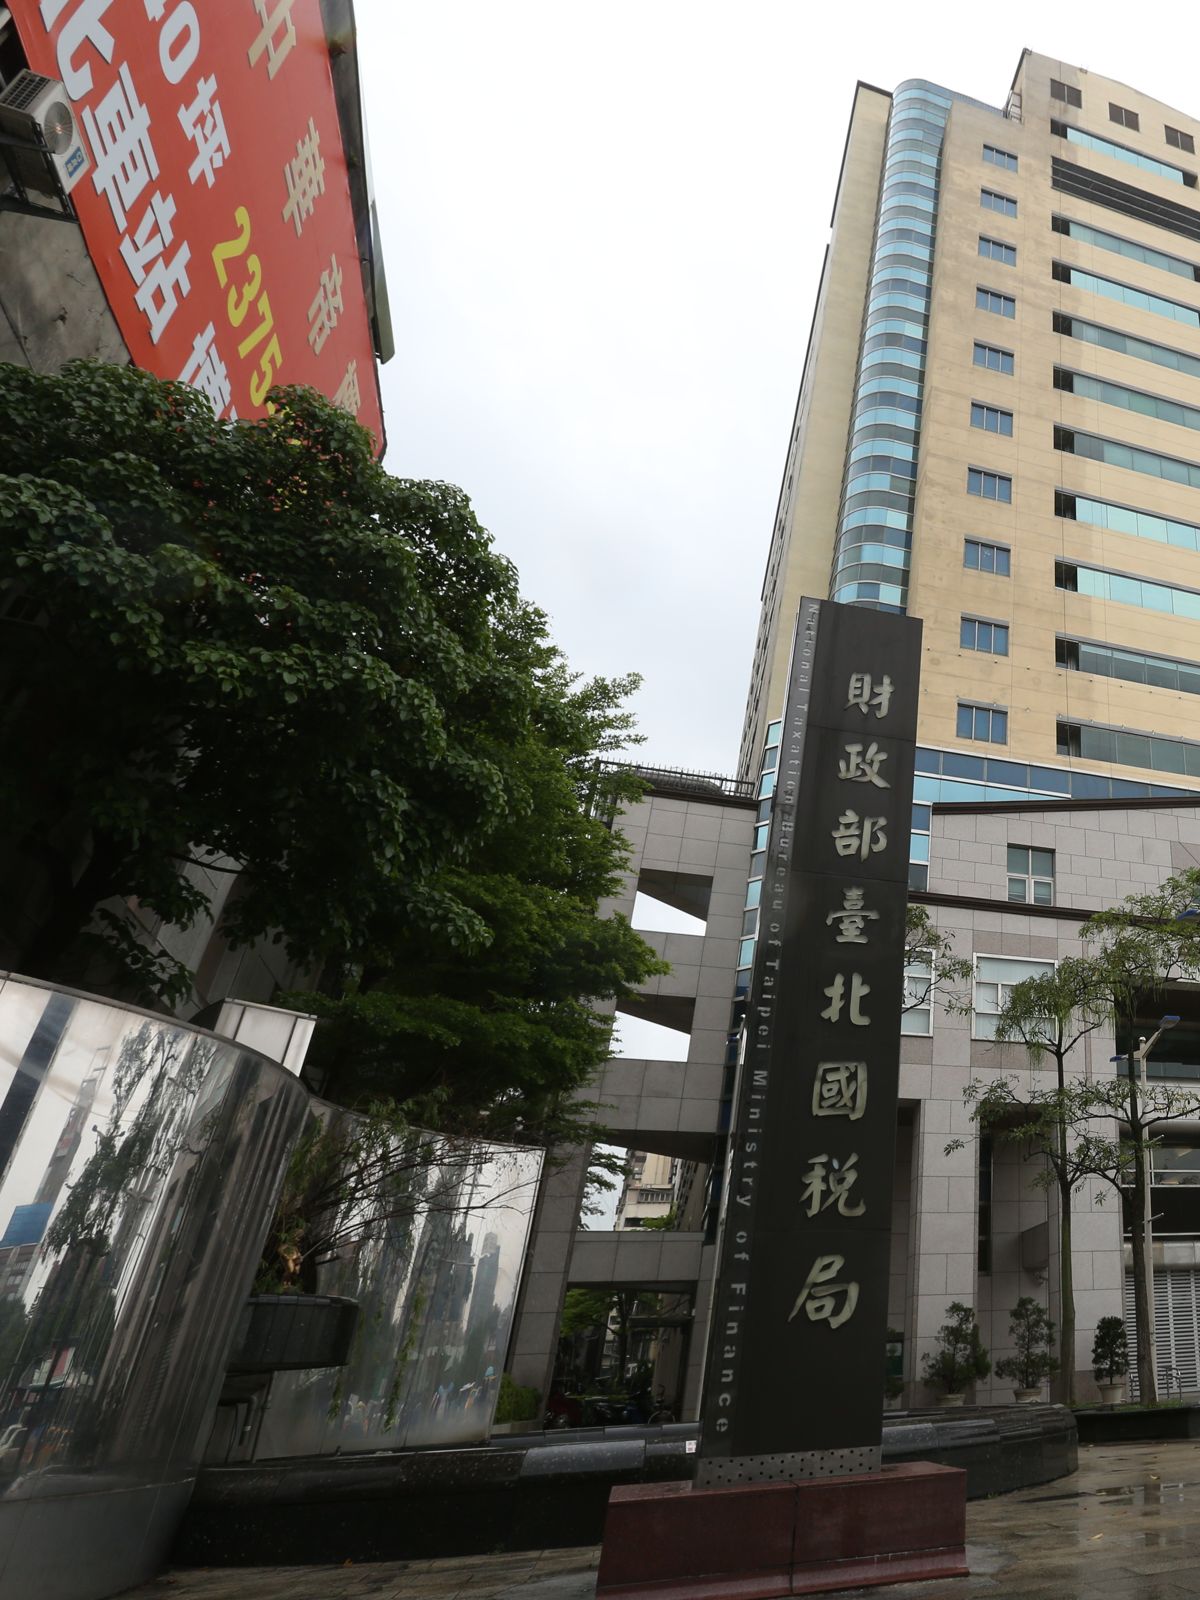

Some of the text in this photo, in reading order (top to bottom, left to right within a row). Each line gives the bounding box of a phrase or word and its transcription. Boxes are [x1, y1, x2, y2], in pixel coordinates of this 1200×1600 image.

[716, 603, 820, 1432] National Taxation Bureau of Taipei Ministry of Finance
